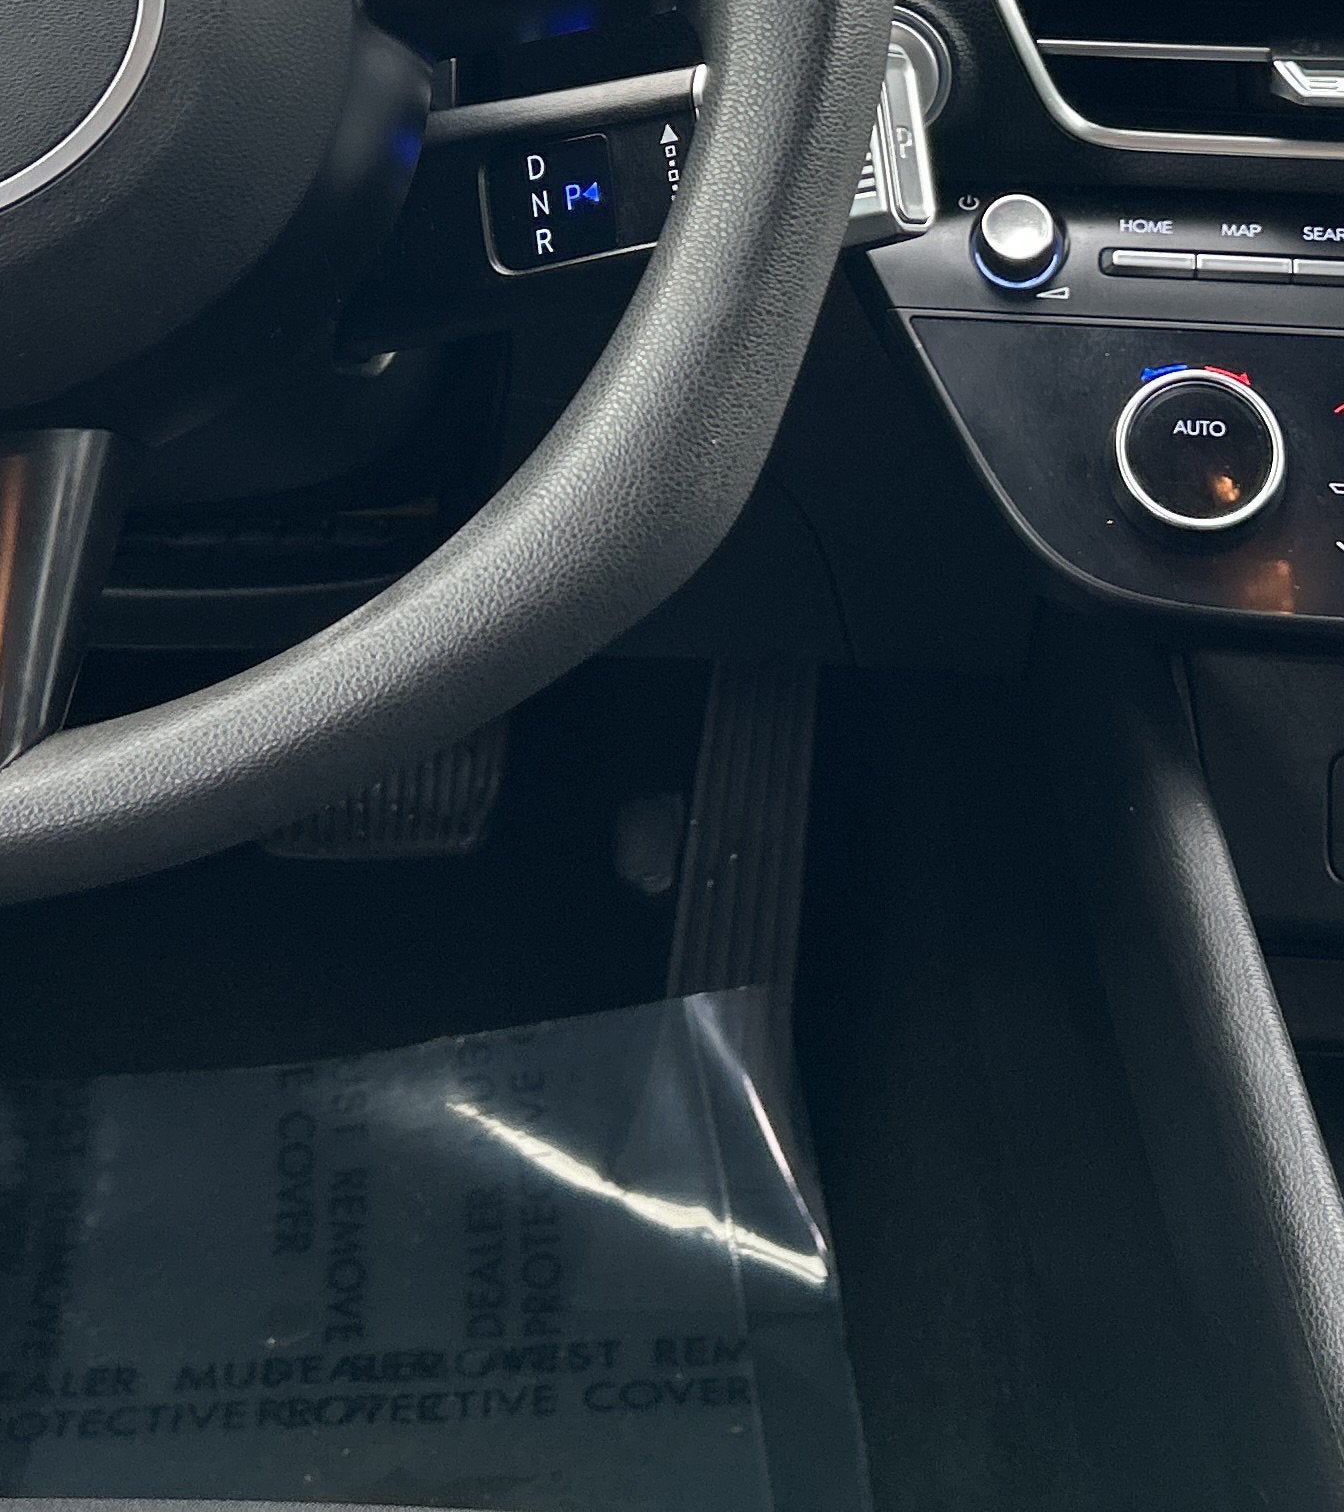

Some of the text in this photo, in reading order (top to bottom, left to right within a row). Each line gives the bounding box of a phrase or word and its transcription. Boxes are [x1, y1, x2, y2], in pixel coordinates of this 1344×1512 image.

[527, 155, 545, 180] D
[532, 191, 550, 217] N
[565, 184, 581, 210] P
[1120, 220, 1173, 236] HOME
[1221, 224, 1261, 239] MAP
[536, 228, 553, 254] R
[1173, 419, 1226, 438] AUTO
[582, 1374, 754, 1412] COVER
